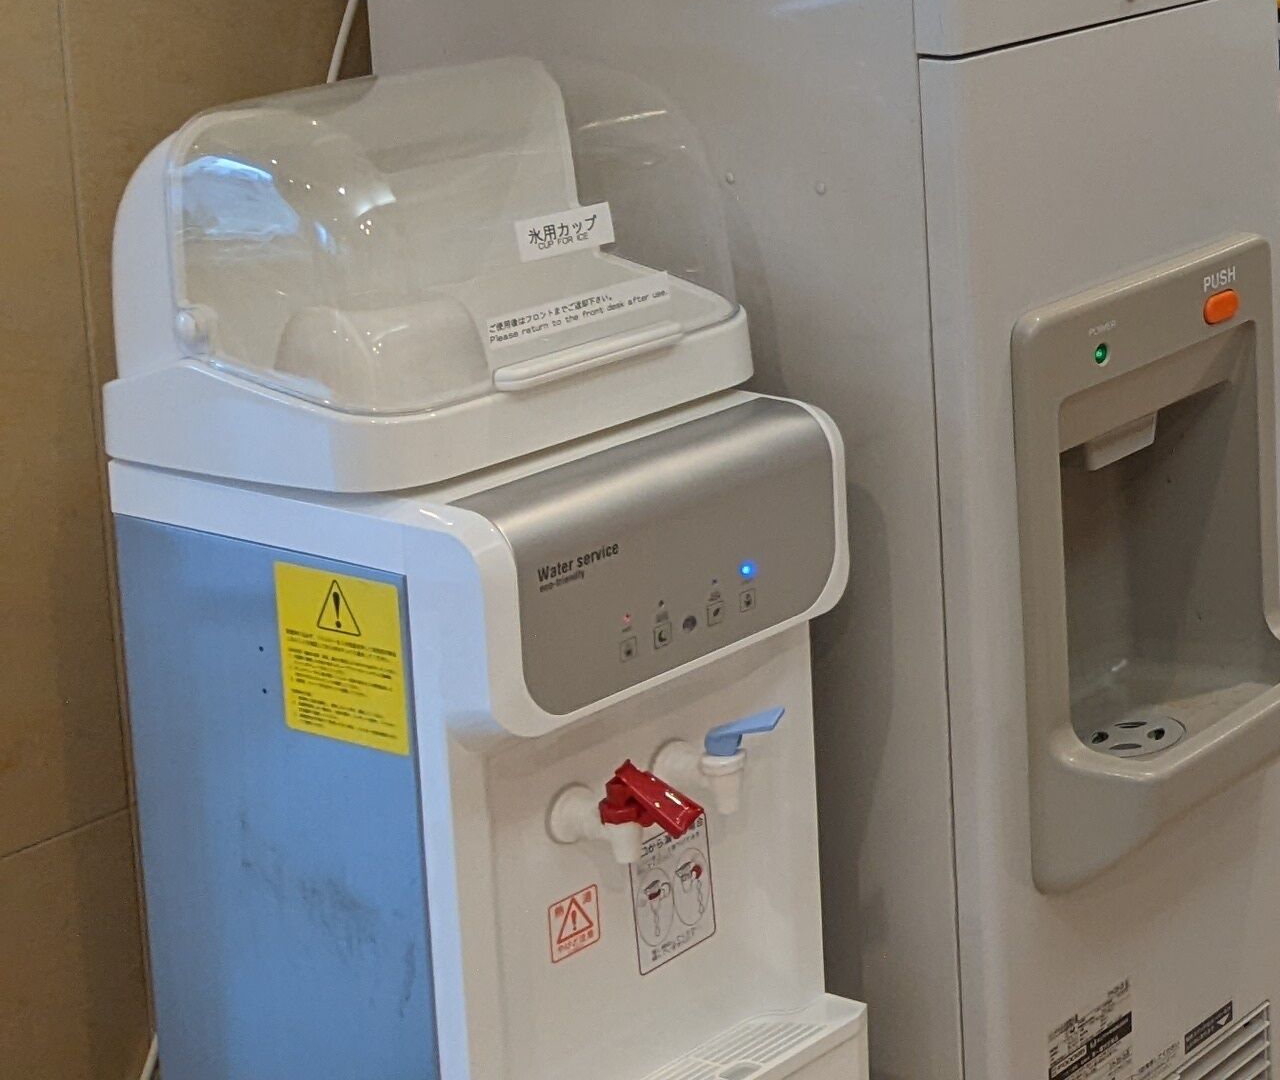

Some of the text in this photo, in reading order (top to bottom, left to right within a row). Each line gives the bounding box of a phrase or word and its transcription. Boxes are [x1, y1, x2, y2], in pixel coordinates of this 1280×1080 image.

[528, 214, 598, 246] 氷用カップ
[538, 231, 589, 251] CUP FOR ICE
[1203, 266, 1237, 293] PUSH
[489, 330, 519, 344] Please
[521, 323, 549, 338] return
[552, 318, 562, 328] to
[565, 313, 579, 325] the
[582, 306, 605, 320] front
[627, 294, 650, 307] after
[536, 542, 620, 583] Water service
